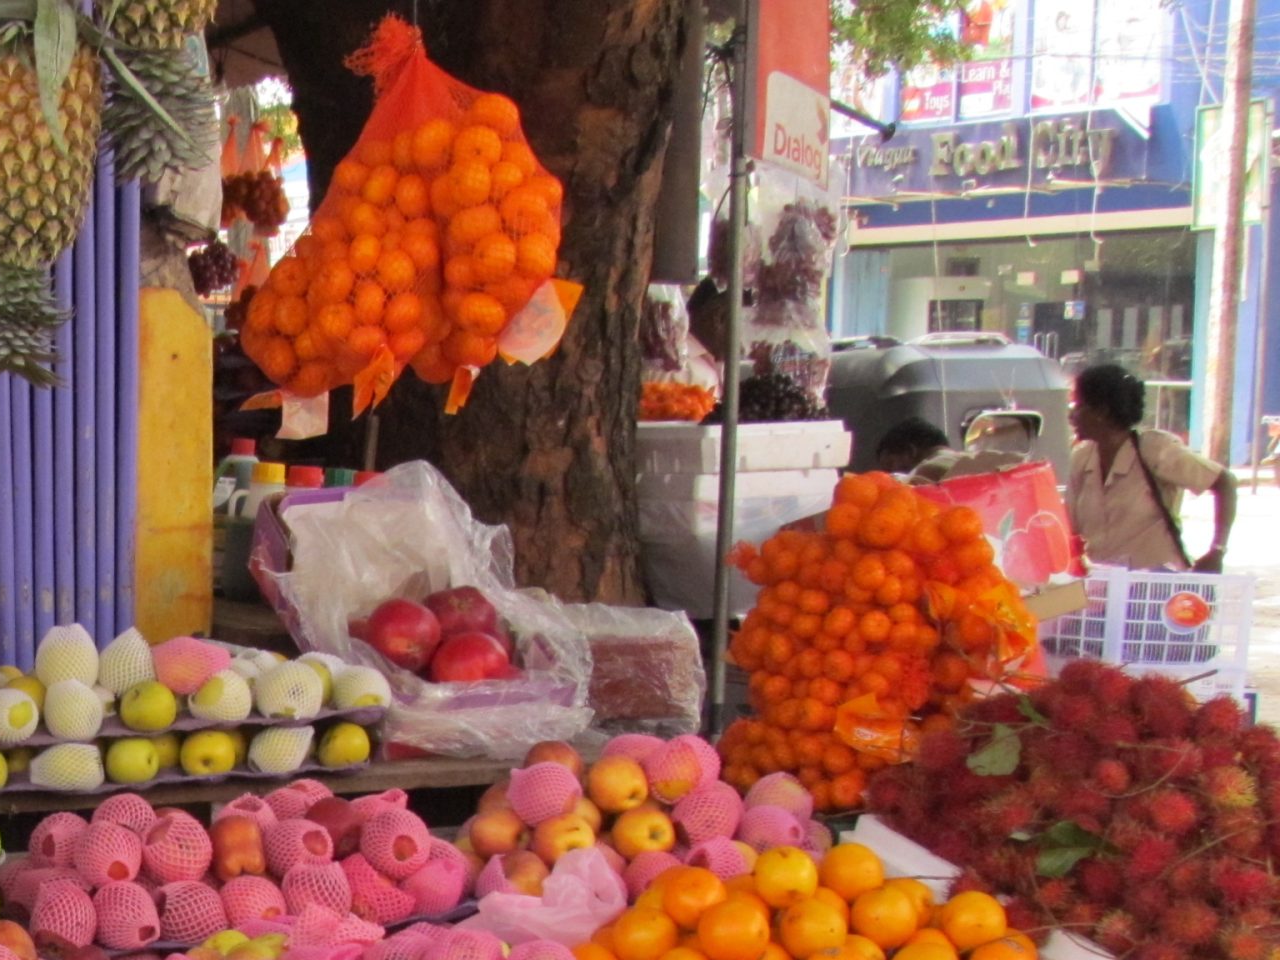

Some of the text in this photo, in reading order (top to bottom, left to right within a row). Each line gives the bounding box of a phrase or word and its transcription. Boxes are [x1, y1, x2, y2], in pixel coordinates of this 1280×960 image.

[962, 64, 996, 84] Learn
[922, 91, 951, 116] Toys
[773, 121, 823, 180] Dialog
[928, 121, 1023, 177] Food
[1031, 117, 1118, 178] City
